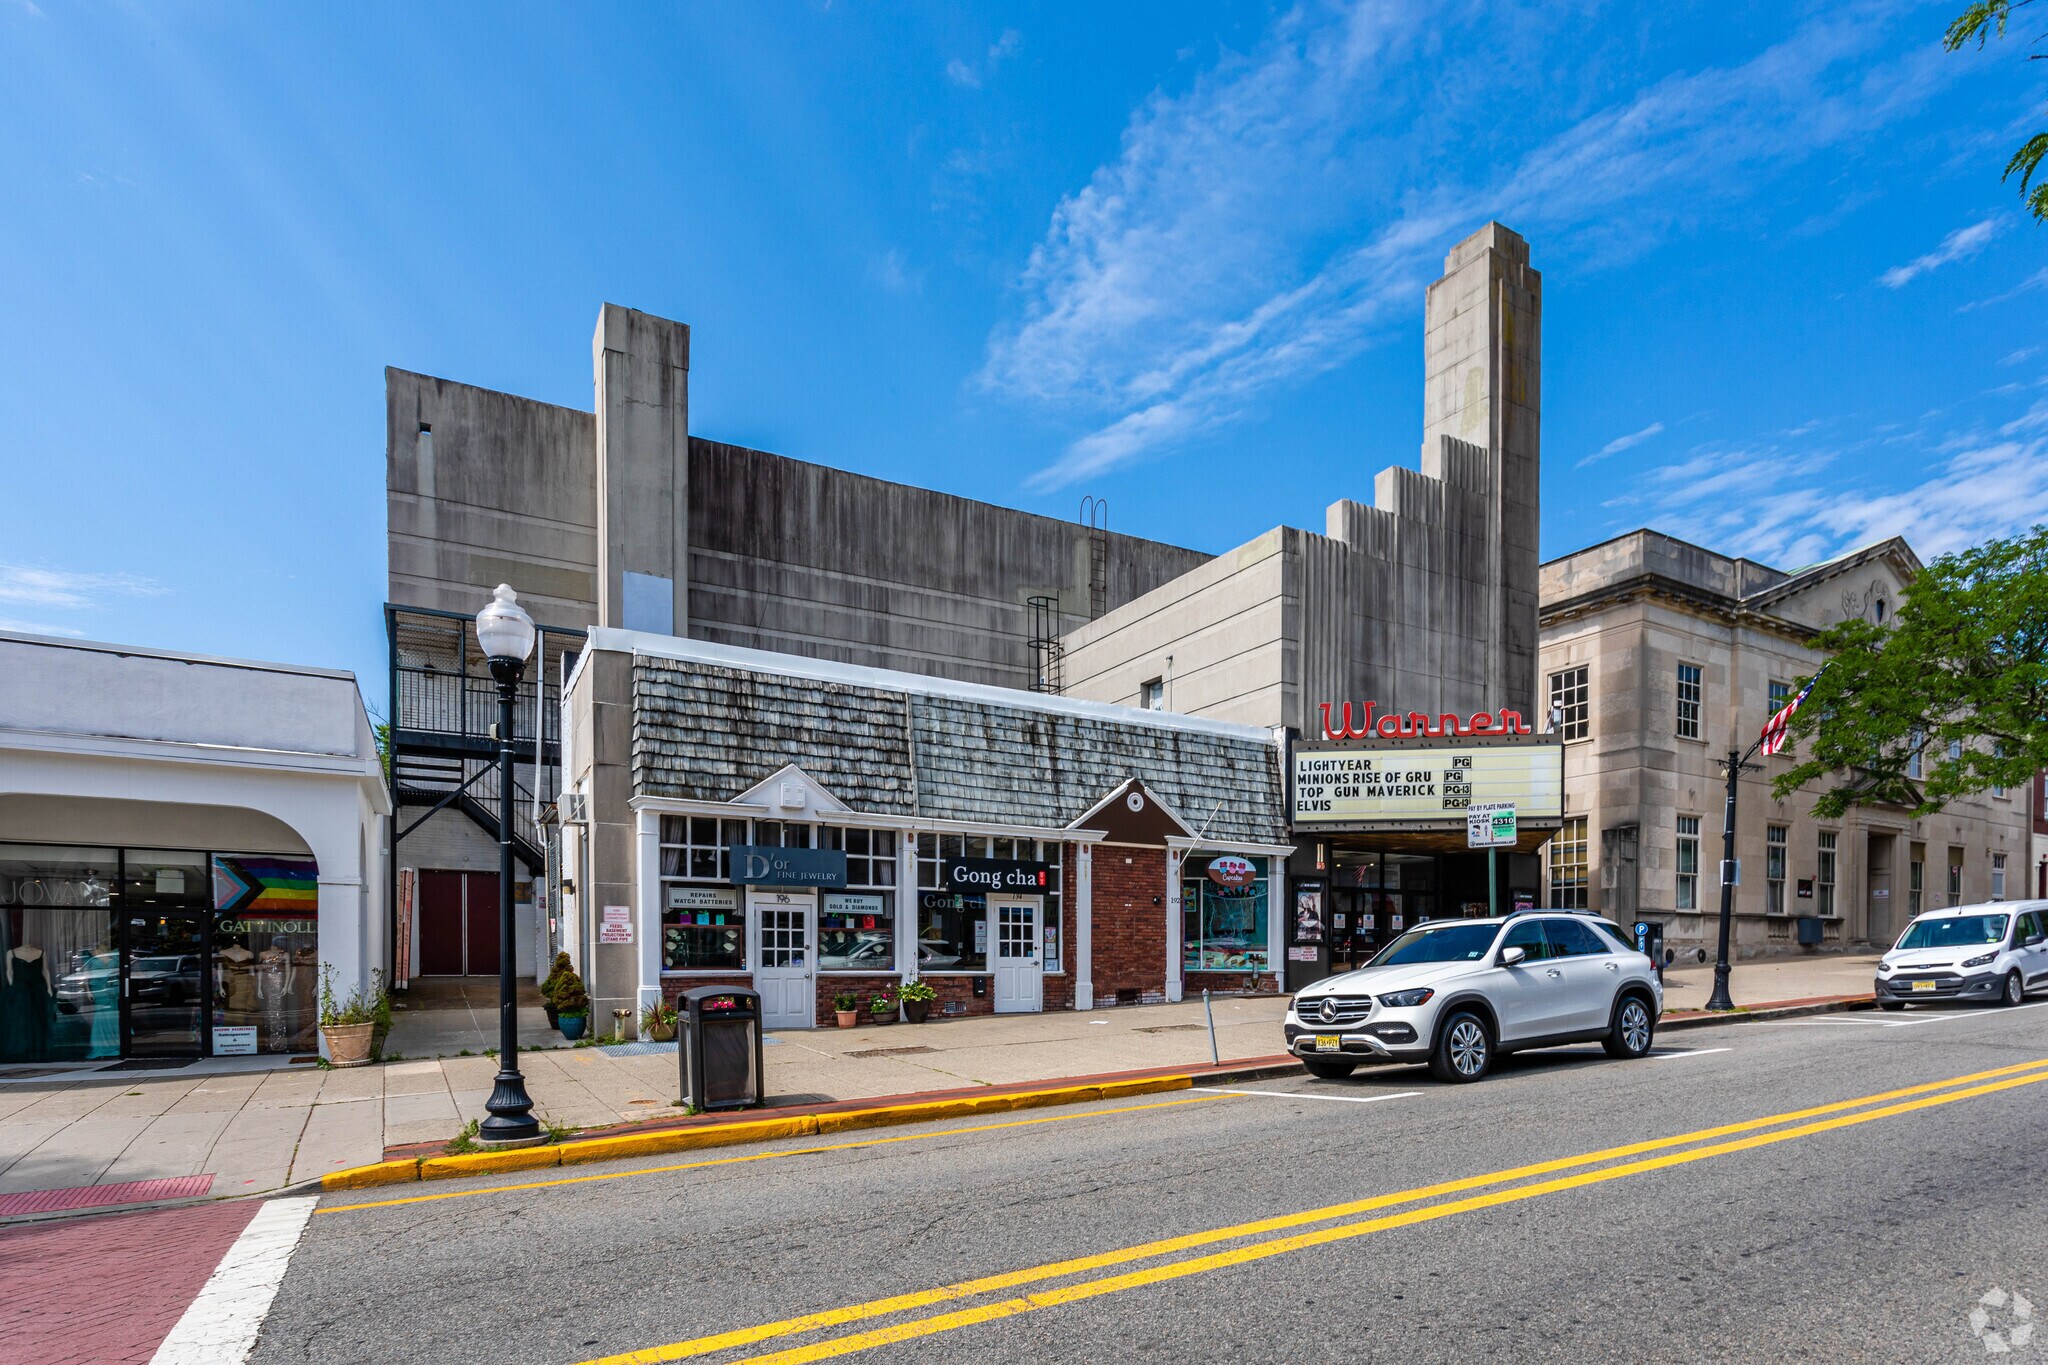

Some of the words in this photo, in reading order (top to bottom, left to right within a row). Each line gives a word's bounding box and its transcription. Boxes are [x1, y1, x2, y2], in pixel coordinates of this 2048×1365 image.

[1319, 701, 1531, 740] Warner
[1300, 759, 1371, 772] LIGHTYEAR
[1454, 758, 1470, 768] PG
[1298, 772, 1350, 785] MINIONS
[1352, 772, 1381, 784] RISE
[1385, 772, 1401, 783] OF
[1405, 771, 1432, 783] GRU
[1445, 772, 1462, 782] PG
[1300, 787, 1324, 798] TOP
[1334, 786, 1360, 798] GUN
[1367, 784, 1435, 797] MAVERICK
[1297, 800, 1331, 811] ELVIS
[1483, 803, 1496, 811] PLATE
[1497, 802, 1515, 810] PARKING
[1493, 817, 1514, 825] 4310
[743, 852, 790, 879] D'or
[777, 871, 797, 879] FINE
[800, 872, 837, 880] JEWELRY
[953, 865, 1002, 889] Gong
[1006, 868, 1037, 886] cha
[776, 894, 791, 904] 196
[219, 920, 318, 934] GATTINOLL
